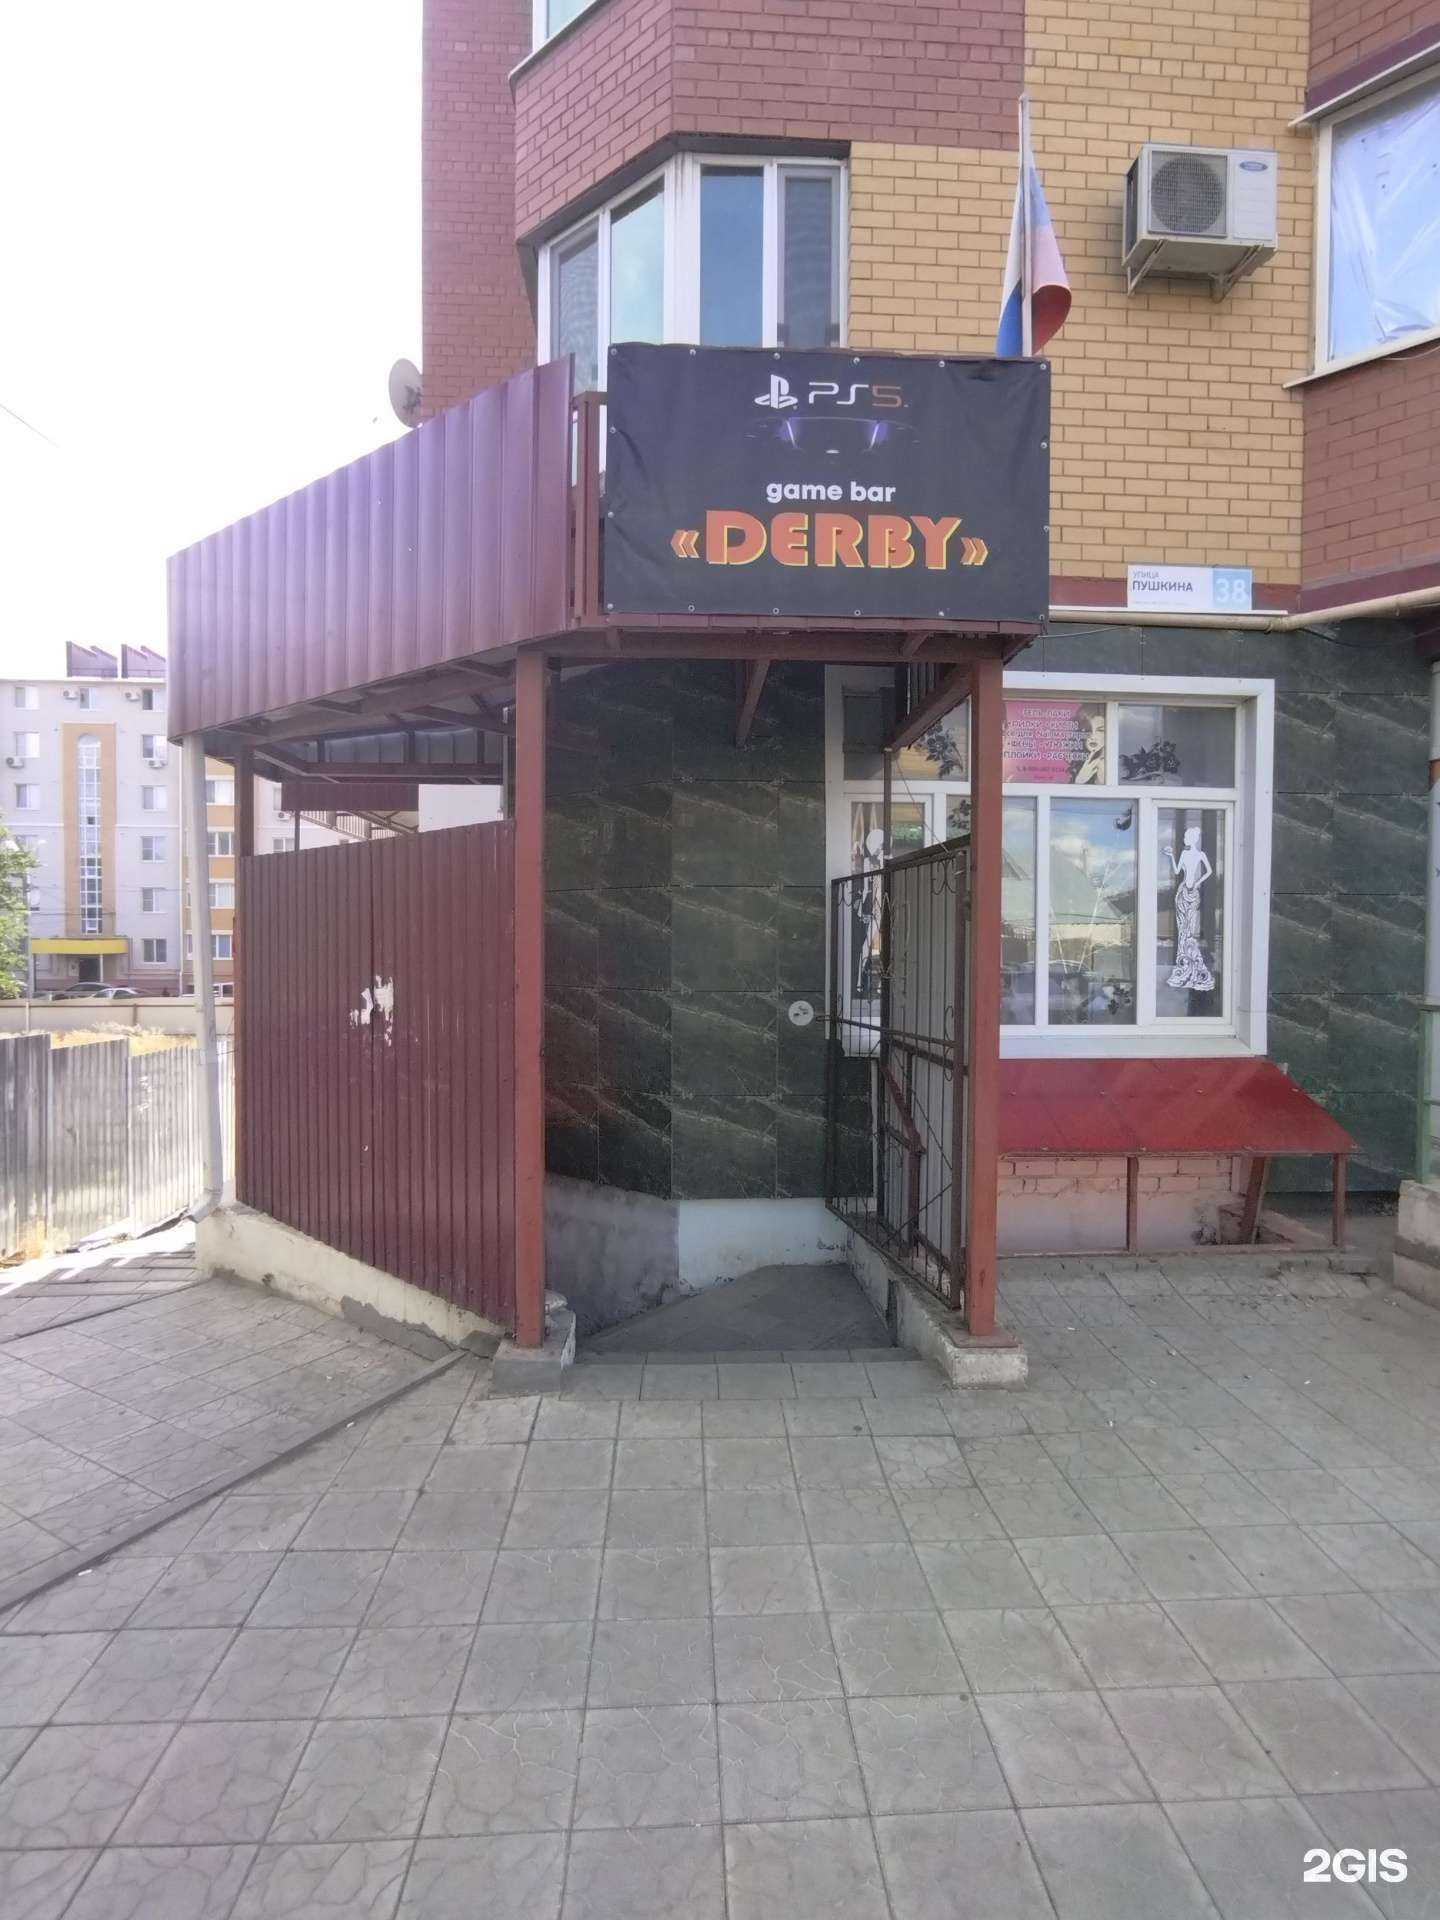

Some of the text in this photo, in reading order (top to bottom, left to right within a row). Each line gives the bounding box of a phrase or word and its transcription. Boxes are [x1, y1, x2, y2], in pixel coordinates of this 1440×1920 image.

[766, 481, 896, 503] game bar
[1131, 580, 1194, 592] ПУШКИНА
[1215, 578, 1249, 603] 38
